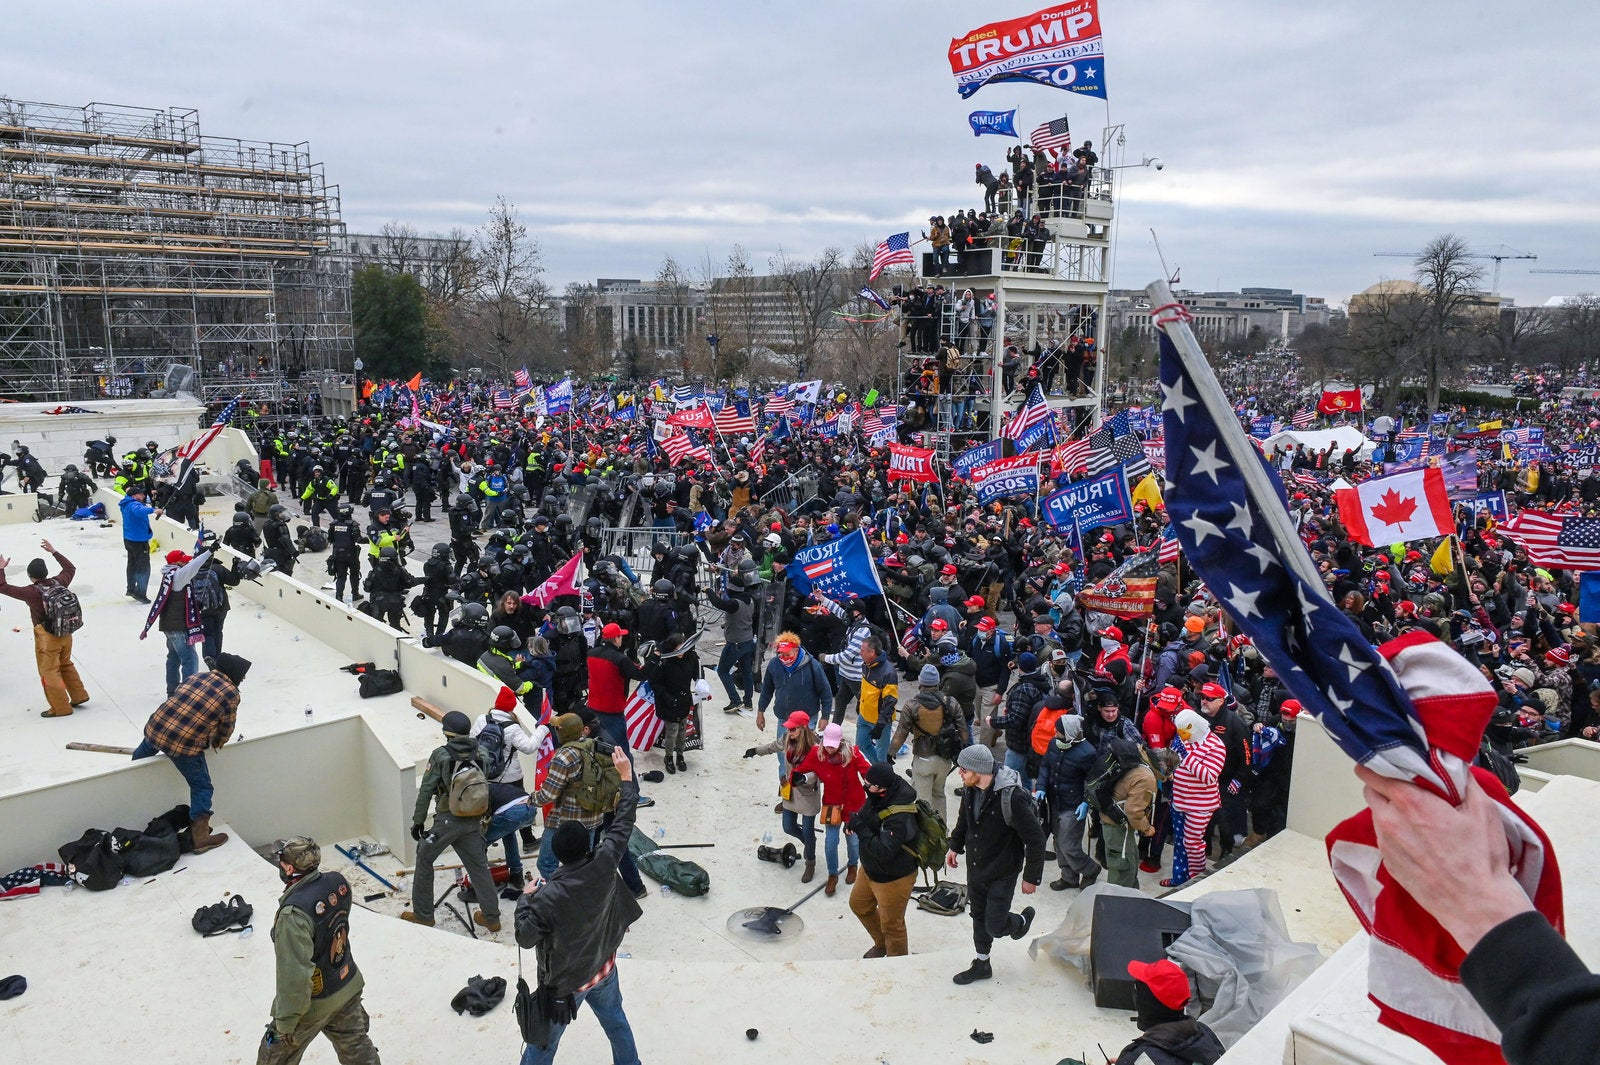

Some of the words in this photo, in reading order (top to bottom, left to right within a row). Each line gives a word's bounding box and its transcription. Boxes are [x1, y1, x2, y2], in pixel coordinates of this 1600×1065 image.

[1041, 4, 1081, 21] Donald
[953, 11, 1093, 66] TRUMP
[961, 69, 993, 83] KEEP
